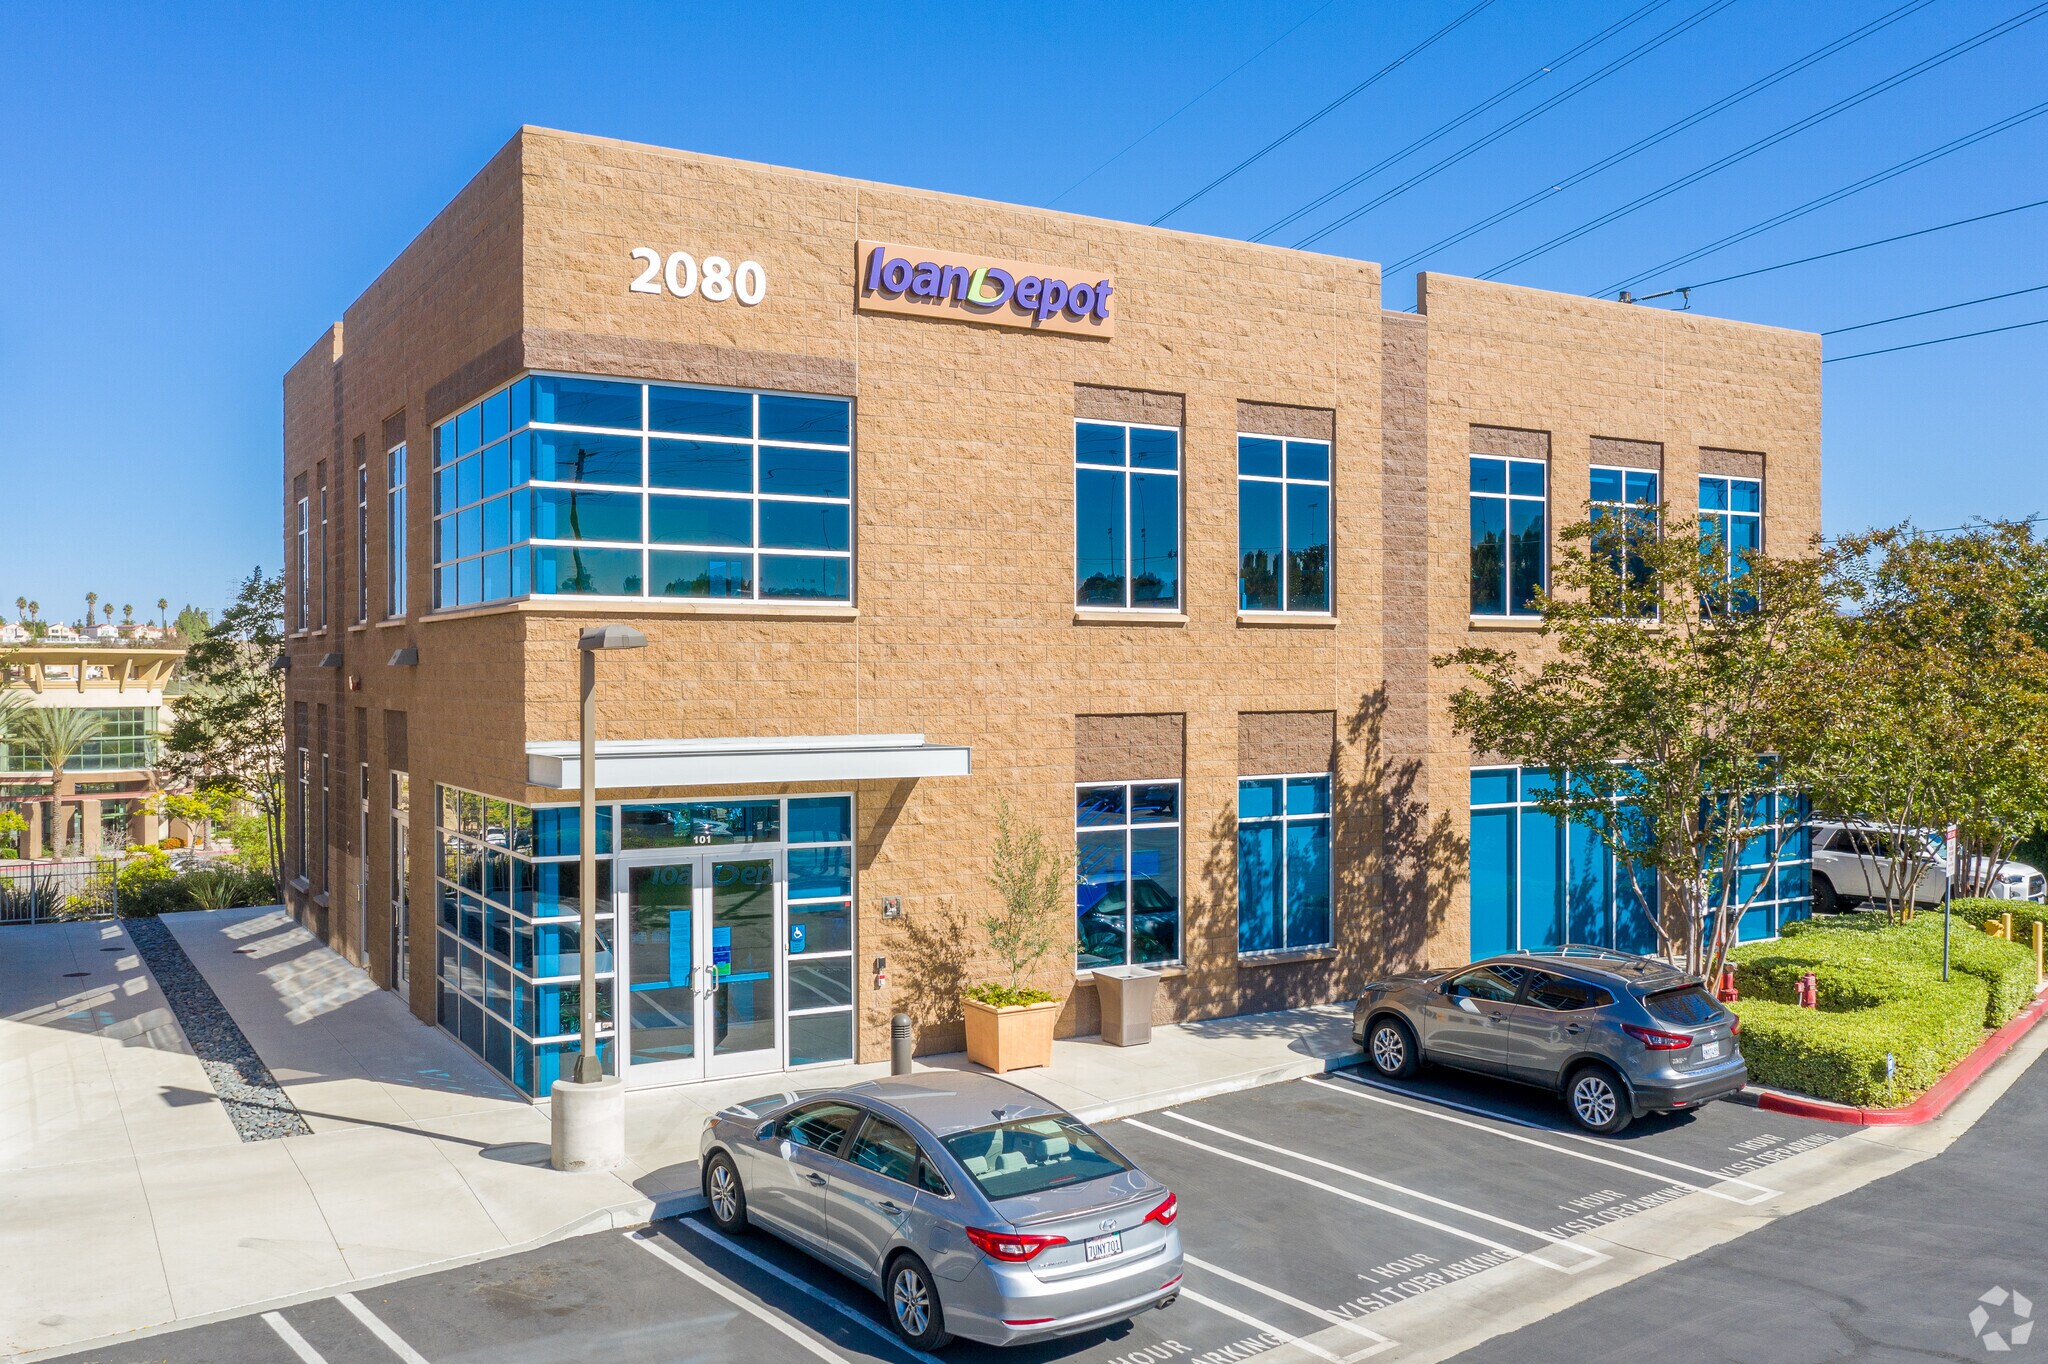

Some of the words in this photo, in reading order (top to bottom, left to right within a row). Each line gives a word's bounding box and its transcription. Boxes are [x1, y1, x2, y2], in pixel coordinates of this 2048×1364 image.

[629, 247, 767, 306] 2080
[867, 246, 1113, 321] loanDepot
[693, 835, 712, 844] 101
[1711, 1150, 1790, 1177] VISITOR
[1774, 1132, 1840, 1157] PARKING
[1727, 1146, 1748, 1154] 1
[1734, 1133, 1785, 1151] HOUR
[1540, 1206, 1638, 1239] VISITOR
[1619, 1184, 1694, 1212] PARKING
[1558, 1205, 1580, 1214] 1
[1567, 1189, 1627, 1210] HOUR
[1088, 1240, 1120, 1258] 7UNY701
[1357, 1273, 1380, 1284] 1
[1370, 1253, 1441, 1278] HOUR
[1326, 1276, 1443, 1319] VISITOR
[1424, 1249, 1515, 1285] PARKING
